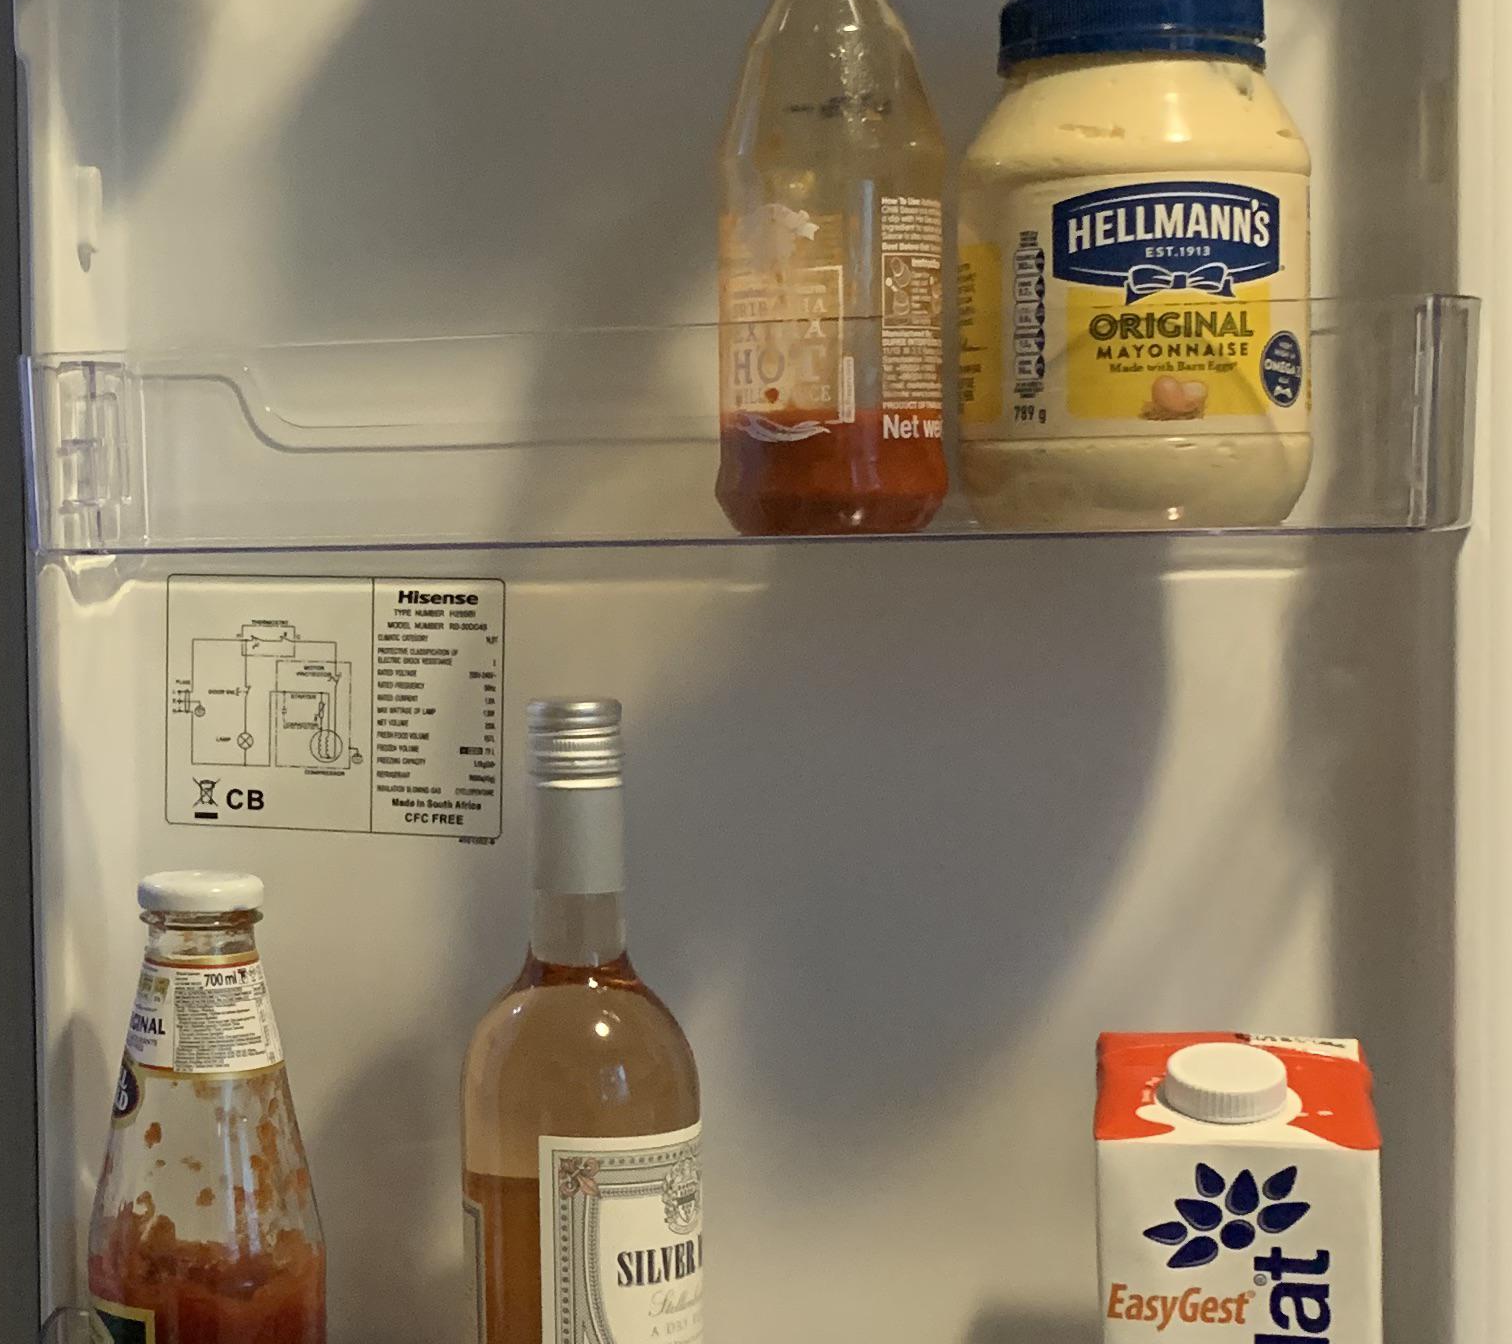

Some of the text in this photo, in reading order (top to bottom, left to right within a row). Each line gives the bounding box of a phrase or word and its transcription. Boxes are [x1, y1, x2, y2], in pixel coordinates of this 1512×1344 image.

[1068, 199, 1270, 254] HELLMANN'S
[1089, 311, 1254, 341] ORIGINAL
[1096, 342, 1249, 360] MAYONNAISE
[1109, 361, 1143, 373] Made
[1147, 361, 1175, 372] with
[1264, 358, 1296, 375] OMEGA
[883, 414, 919, 440] Net
[398, 590, 478, 605] Hisense
[226, 788, 265, 811] CB
[392, 798, 415, 807] Made
[427, 799, 453, 809] South
[455, 800, 482, 810] Africa
[405, 813, 464, 825] CFC FREE
[204, 970, 237, 987] 700 ml
[617, 1239, 695, 1287] SILVER
[1107, 1282, 1249, 1331] EasyGest
